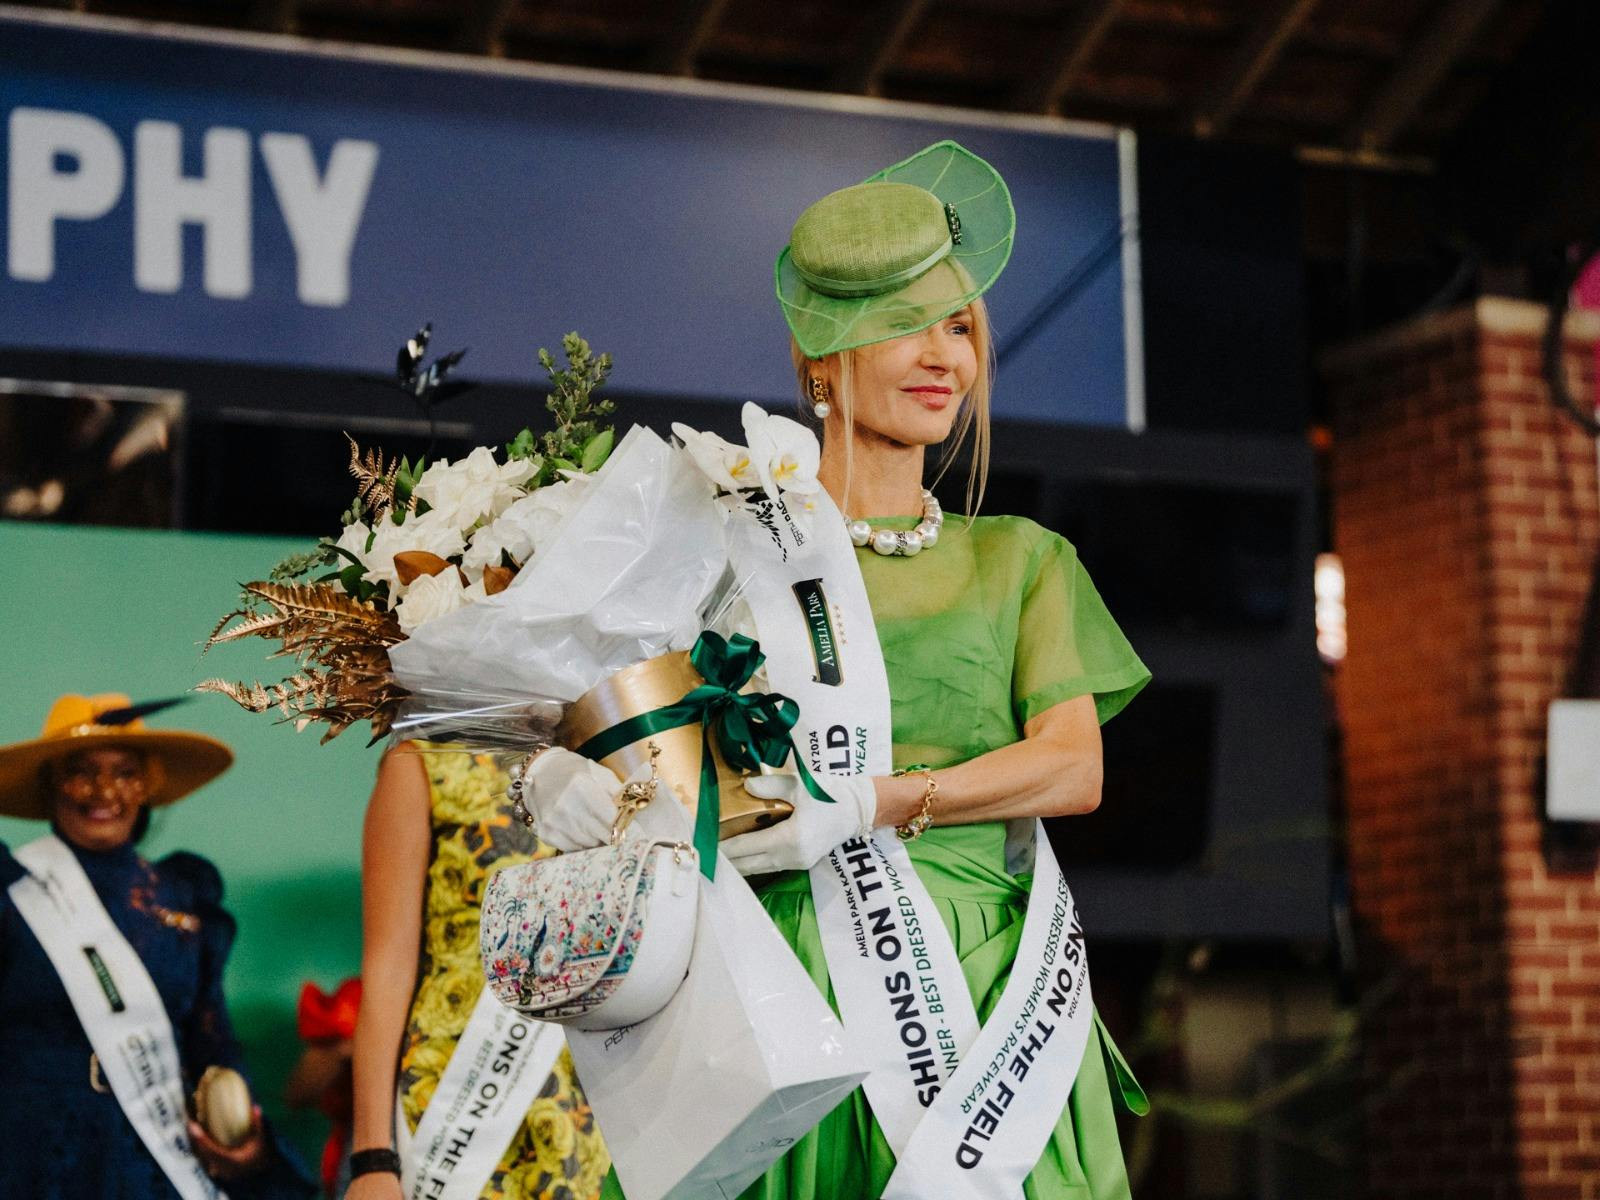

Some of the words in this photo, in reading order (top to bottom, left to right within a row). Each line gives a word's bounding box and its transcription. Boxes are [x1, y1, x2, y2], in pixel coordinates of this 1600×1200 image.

[8, 106, 380, 307] PHY
[776, 497, 791, 522] RAC
[807, 591, 824, 618] PARK
[816, 620, 835, 667] AMELIA
[808, 730, 820, 757] 2024
[826, 724, 851, 776] LD
[855, 726, 867, 775] WEAR
[841, 836, 883, 902] THE
[845, 887, 860, 918] PARK
[854, 918, 869, 957] AMELIA
[867, 906, 902, 962] ON
[897, 896, 932, 971] DRESSED
[1043, 903, 1066, 966] DRESSED
[919, 975, 944, 1014] BEST
[1014, 965, 1051, 1035] WOMEN'S
[1046, 967, 1073, 1017] ON
[1067, 999, 1078, 1020] 2024
[1075, 979, 1084, 999] DAY
[492, 1023, 527, 1077] ONS
[960, 1030, 1018, 1114] RACEWEAR
[1008, 1019, 1056, 1083] THE
[469, 1083, 498, 1118] ON
[955, 1080, 1015, 1170] FIELD
[439, 1127, 476, 1174] THE
